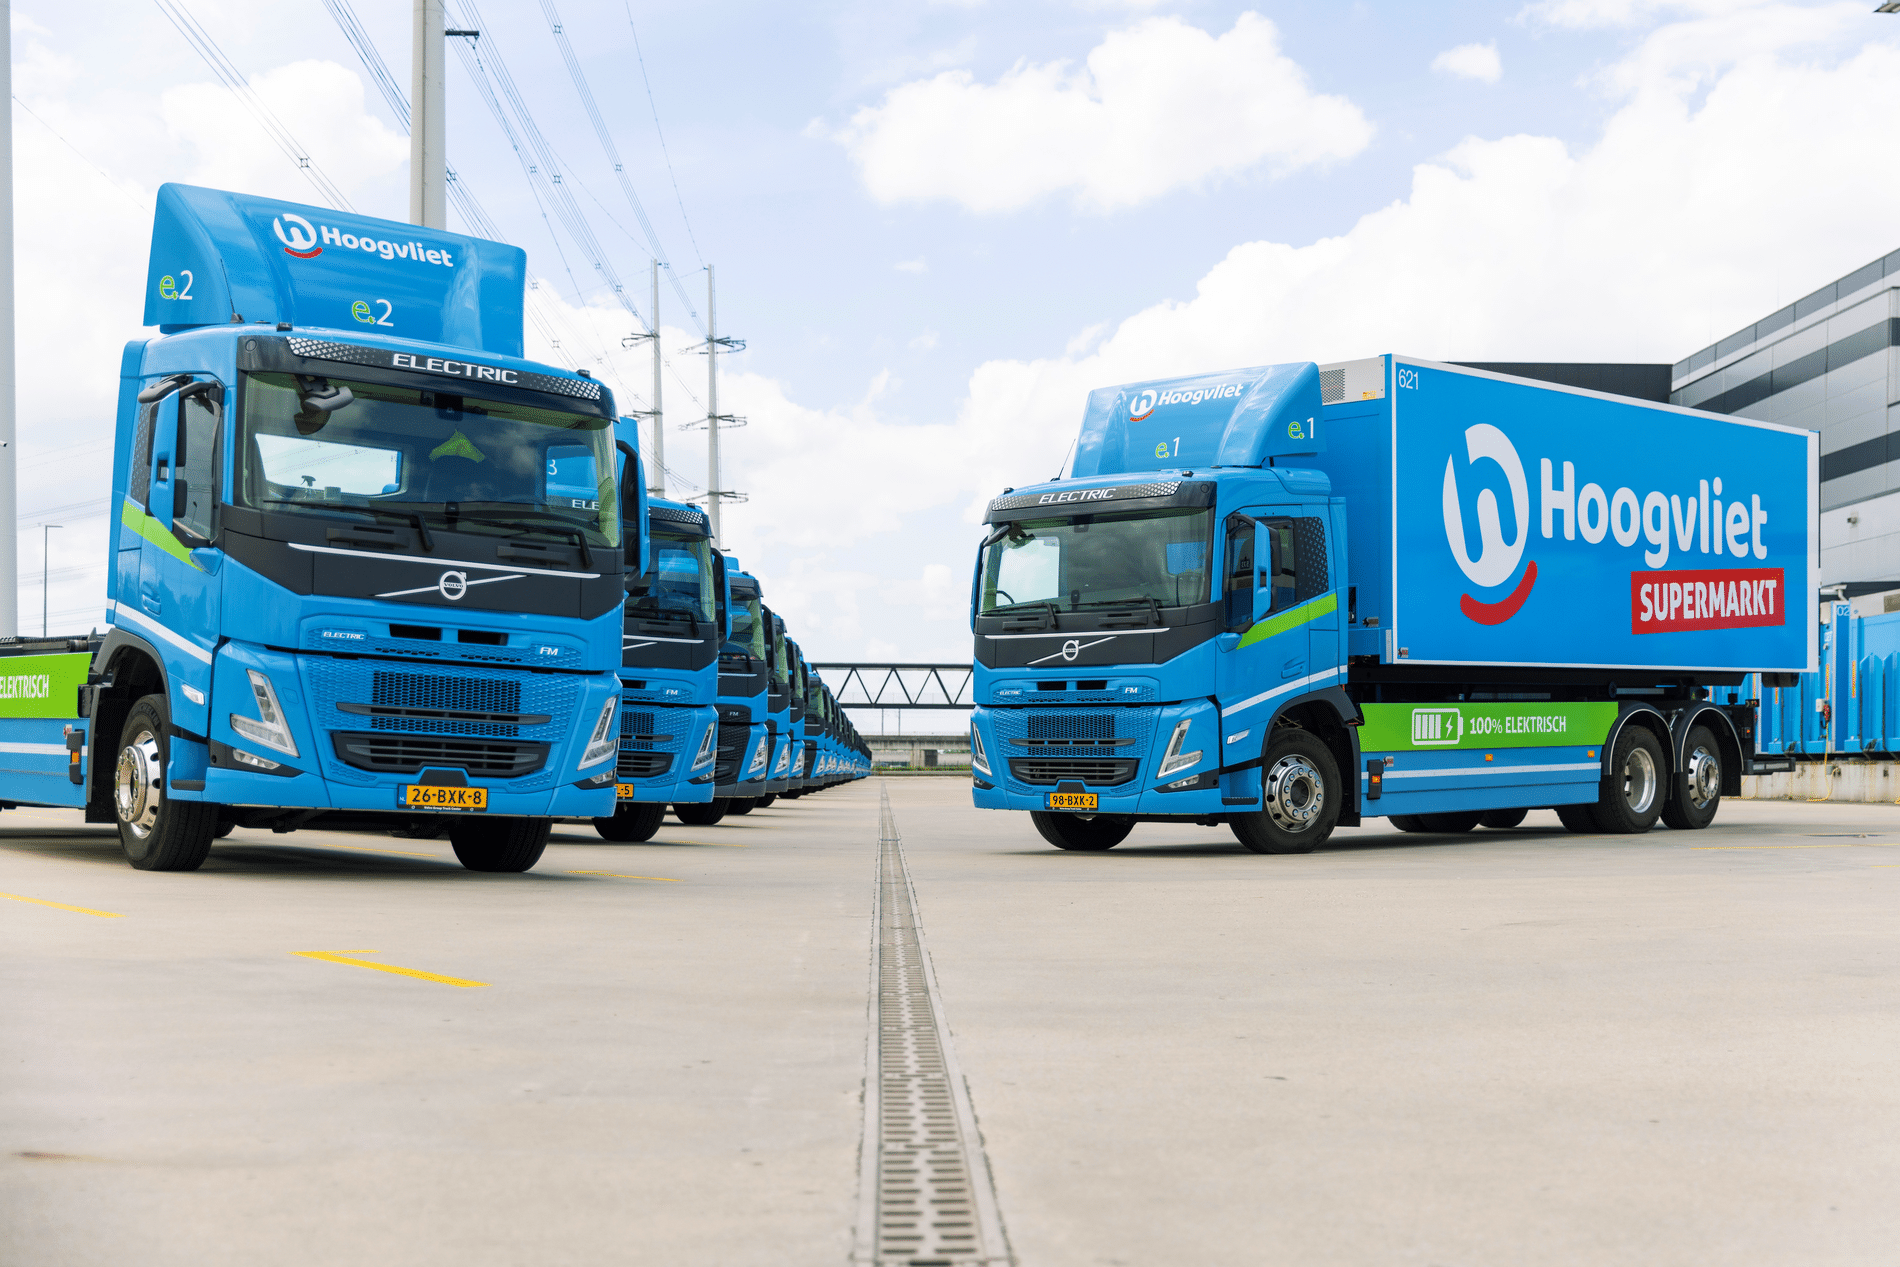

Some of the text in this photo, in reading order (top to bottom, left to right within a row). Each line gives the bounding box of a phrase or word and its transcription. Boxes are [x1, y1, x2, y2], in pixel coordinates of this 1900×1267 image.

[321, 225, 454, 267] Hoogvliet
[392, 353, 518, 384] ELECTRIC
[1398, 368, 1419, 390] 621
[1158, 383, 1244, 406] Hoogvliet
[1038, 488, 1117, 504] ELECTRIC
[1540, 457, 1768, 569] Hoogvliet
[1640, 579, 1777, 622] SUPERMARKT
[323, 631, 365, 640] ELECTRIC
[540, 646, 559, 656] FM
[0, 674, 49, 699] ELEKTRISCH
[666, 688, 679, 696] FM
[1470, 715, 1567, 735] 100% ELEKTRISCH
[412, 788, 482, 805] 26-BXK-8
[1052, 795, 1094, 806] 98-BXK-2
